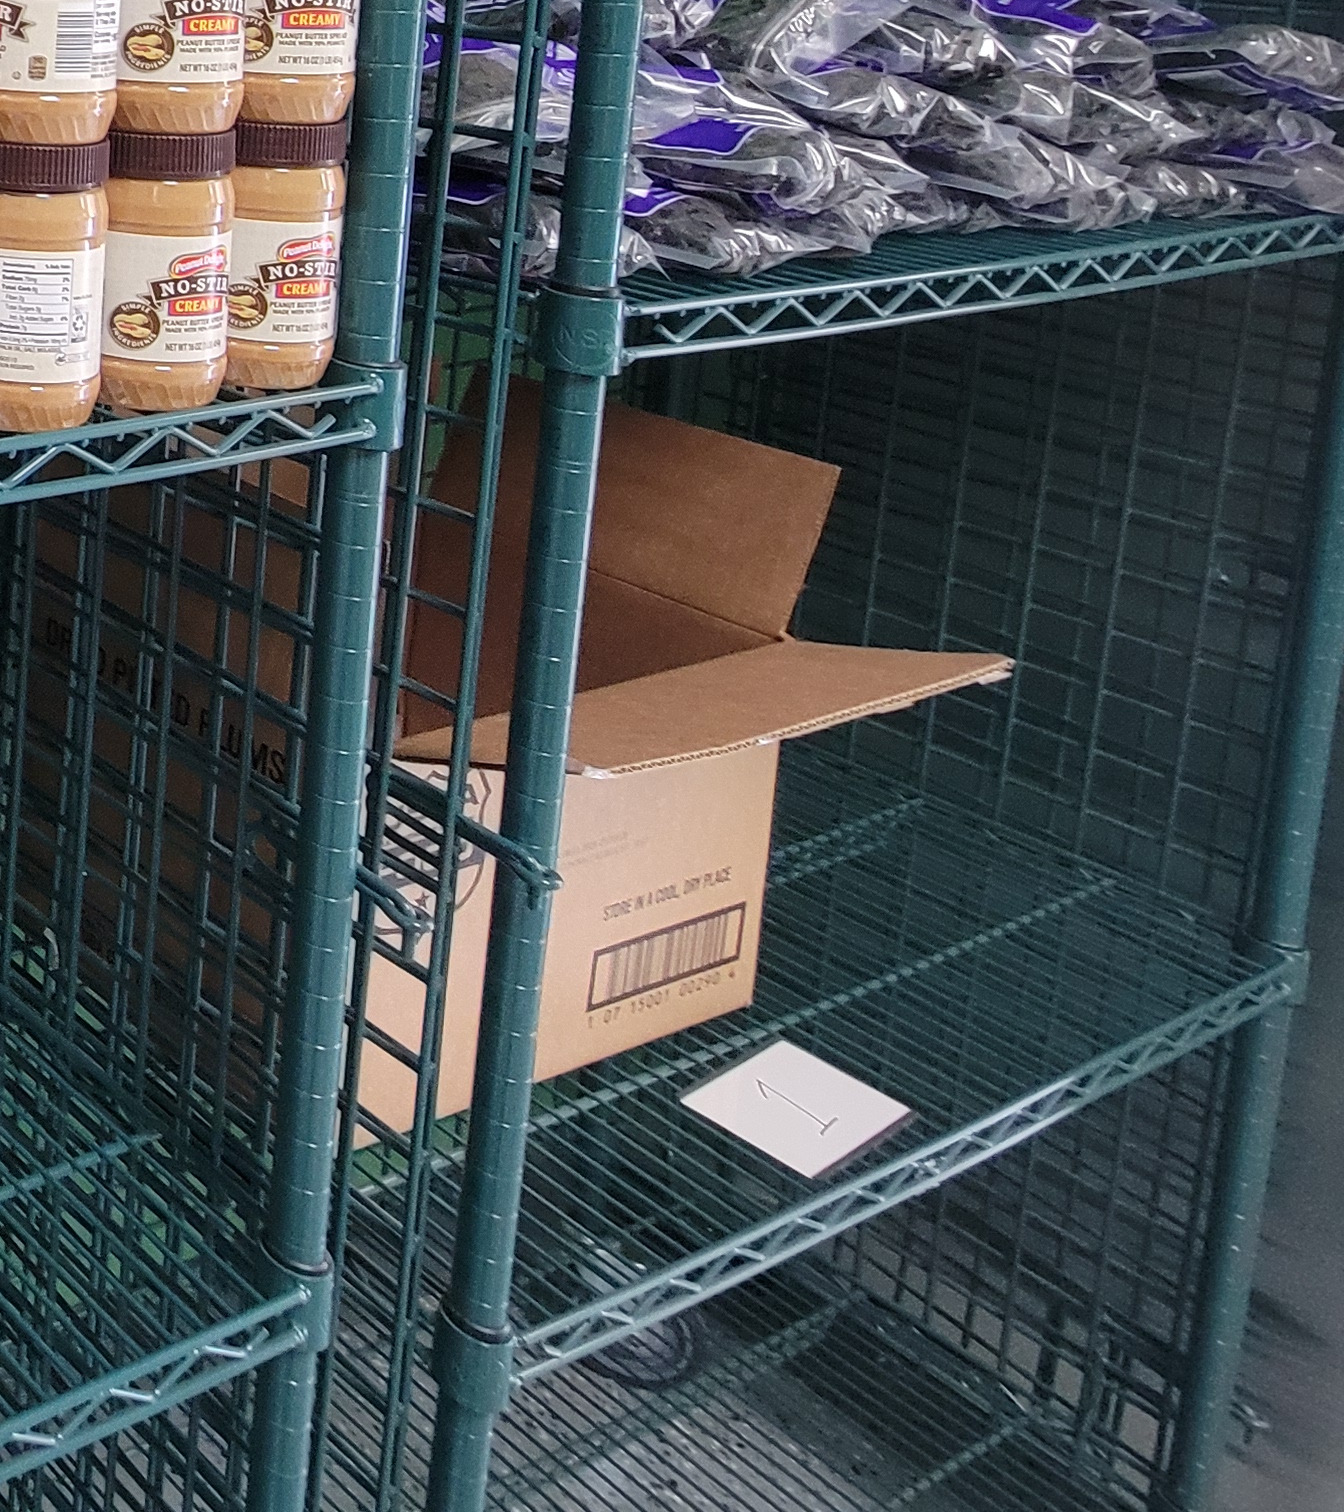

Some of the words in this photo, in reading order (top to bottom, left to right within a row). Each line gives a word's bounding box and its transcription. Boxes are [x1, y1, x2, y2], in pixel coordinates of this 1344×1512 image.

[190, 18, 235, 32] CREAMY
[290, 13, 341, 25] CREAMY
[756, 1079, 839, 1137] 1
